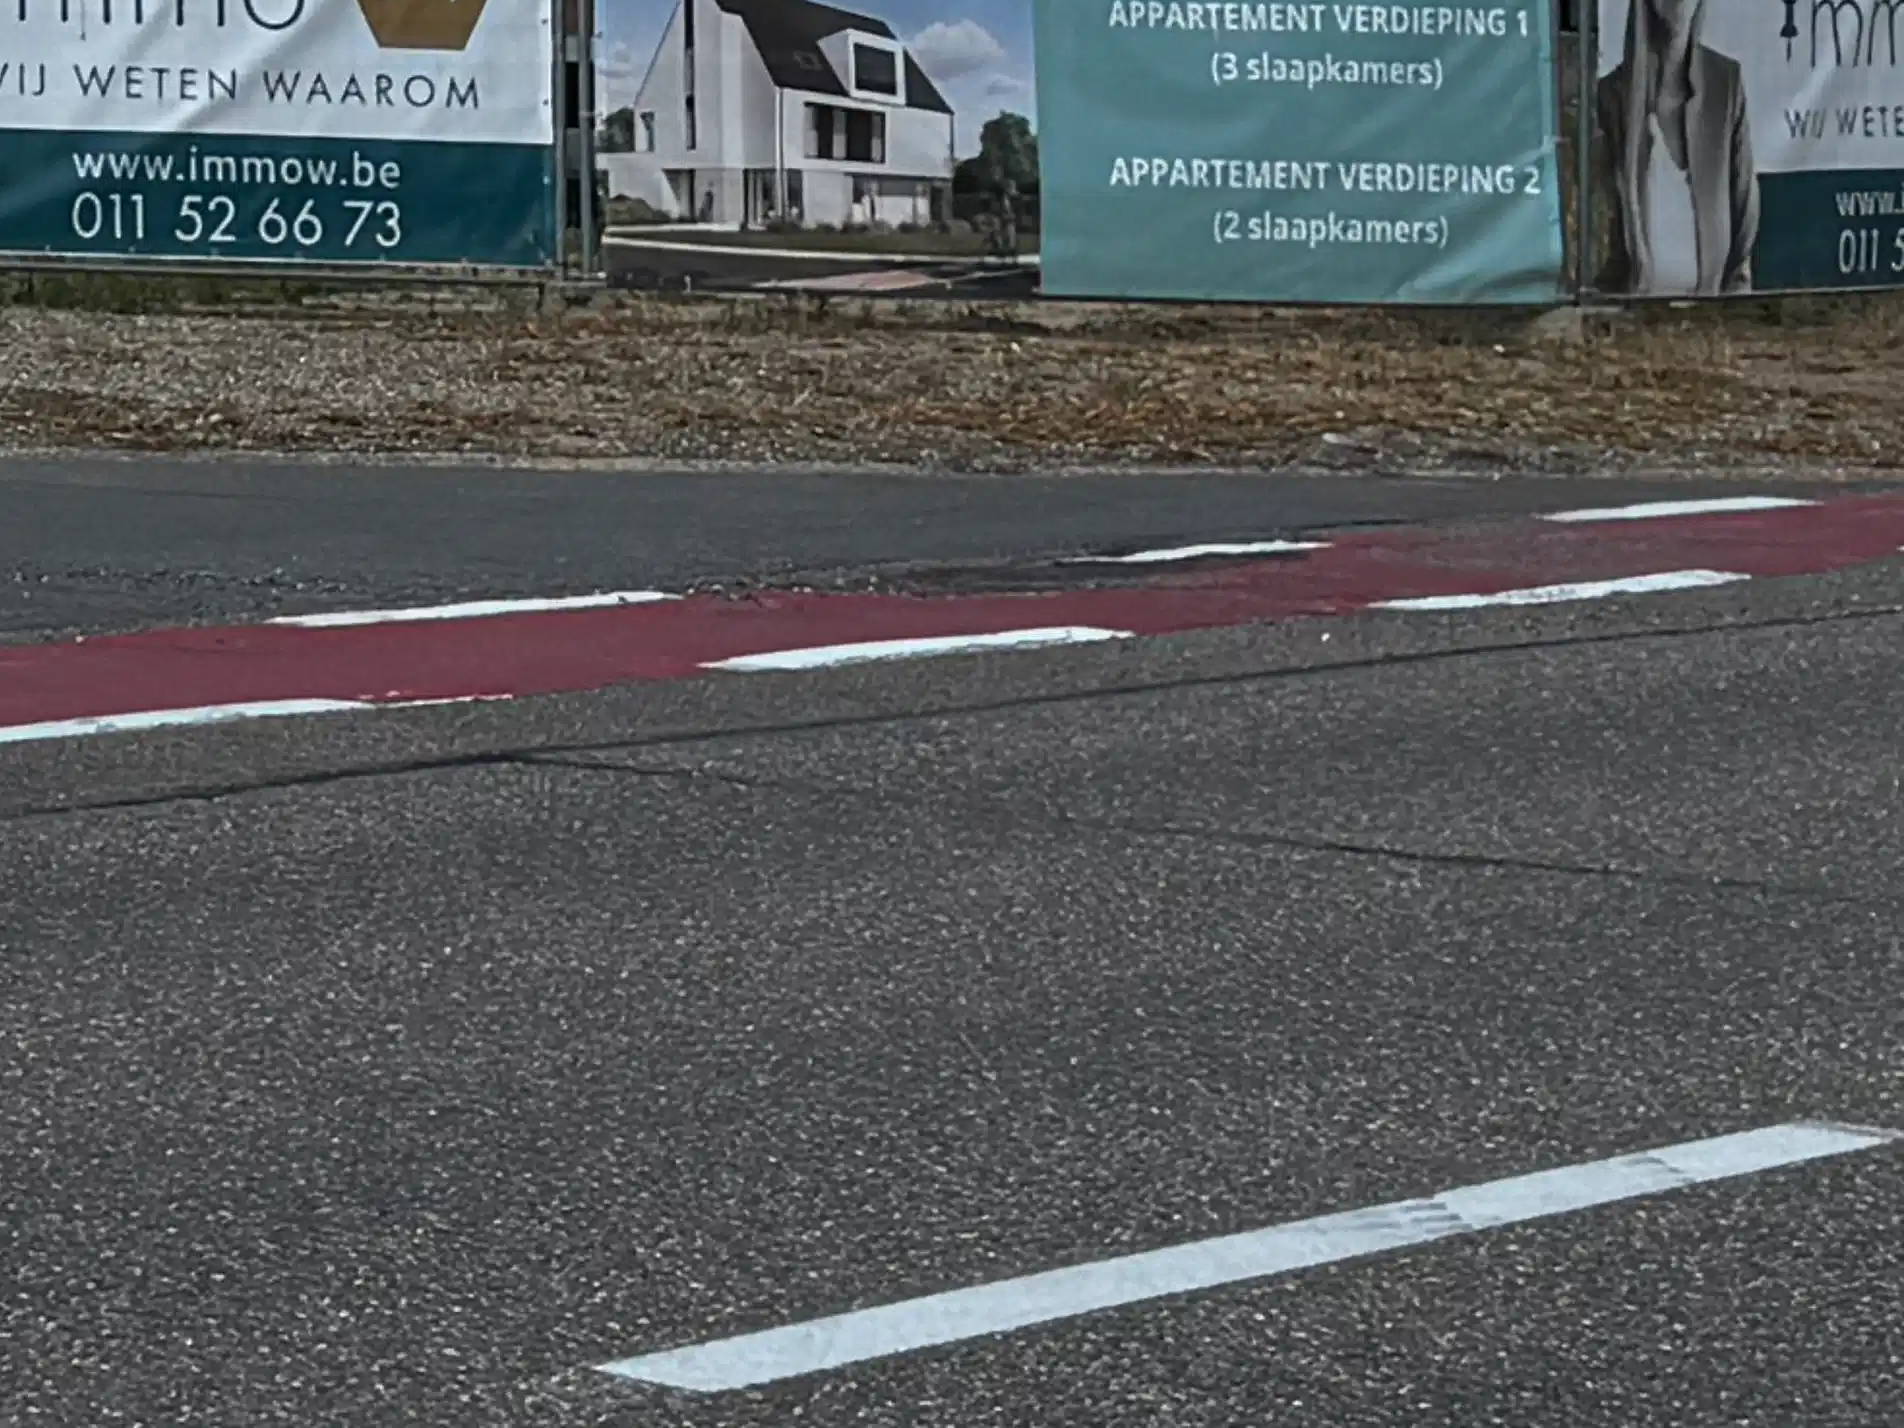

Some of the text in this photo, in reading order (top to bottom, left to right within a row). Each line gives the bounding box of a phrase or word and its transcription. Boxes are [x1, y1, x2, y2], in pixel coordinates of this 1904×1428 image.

[1108, 0, 1529, 37] APPARTEMENT VERDIEPING 1
[74, 63, 238, 102] WETEN
[264, 70, 482, 108] WAAROM
[1211, 52, 1443, 90] (3 slaapkamers)
[73, 145, 402, 188] www.immow.be
[1109, 157, 1542, 195] APPARTEMENT VERDIEPING 2
[73, 191, 402, 248] 011 52 66 73
[1213, 209, 1449, 248] (2 slaapkamers)
[1838, 227, 1880, 275] 011
